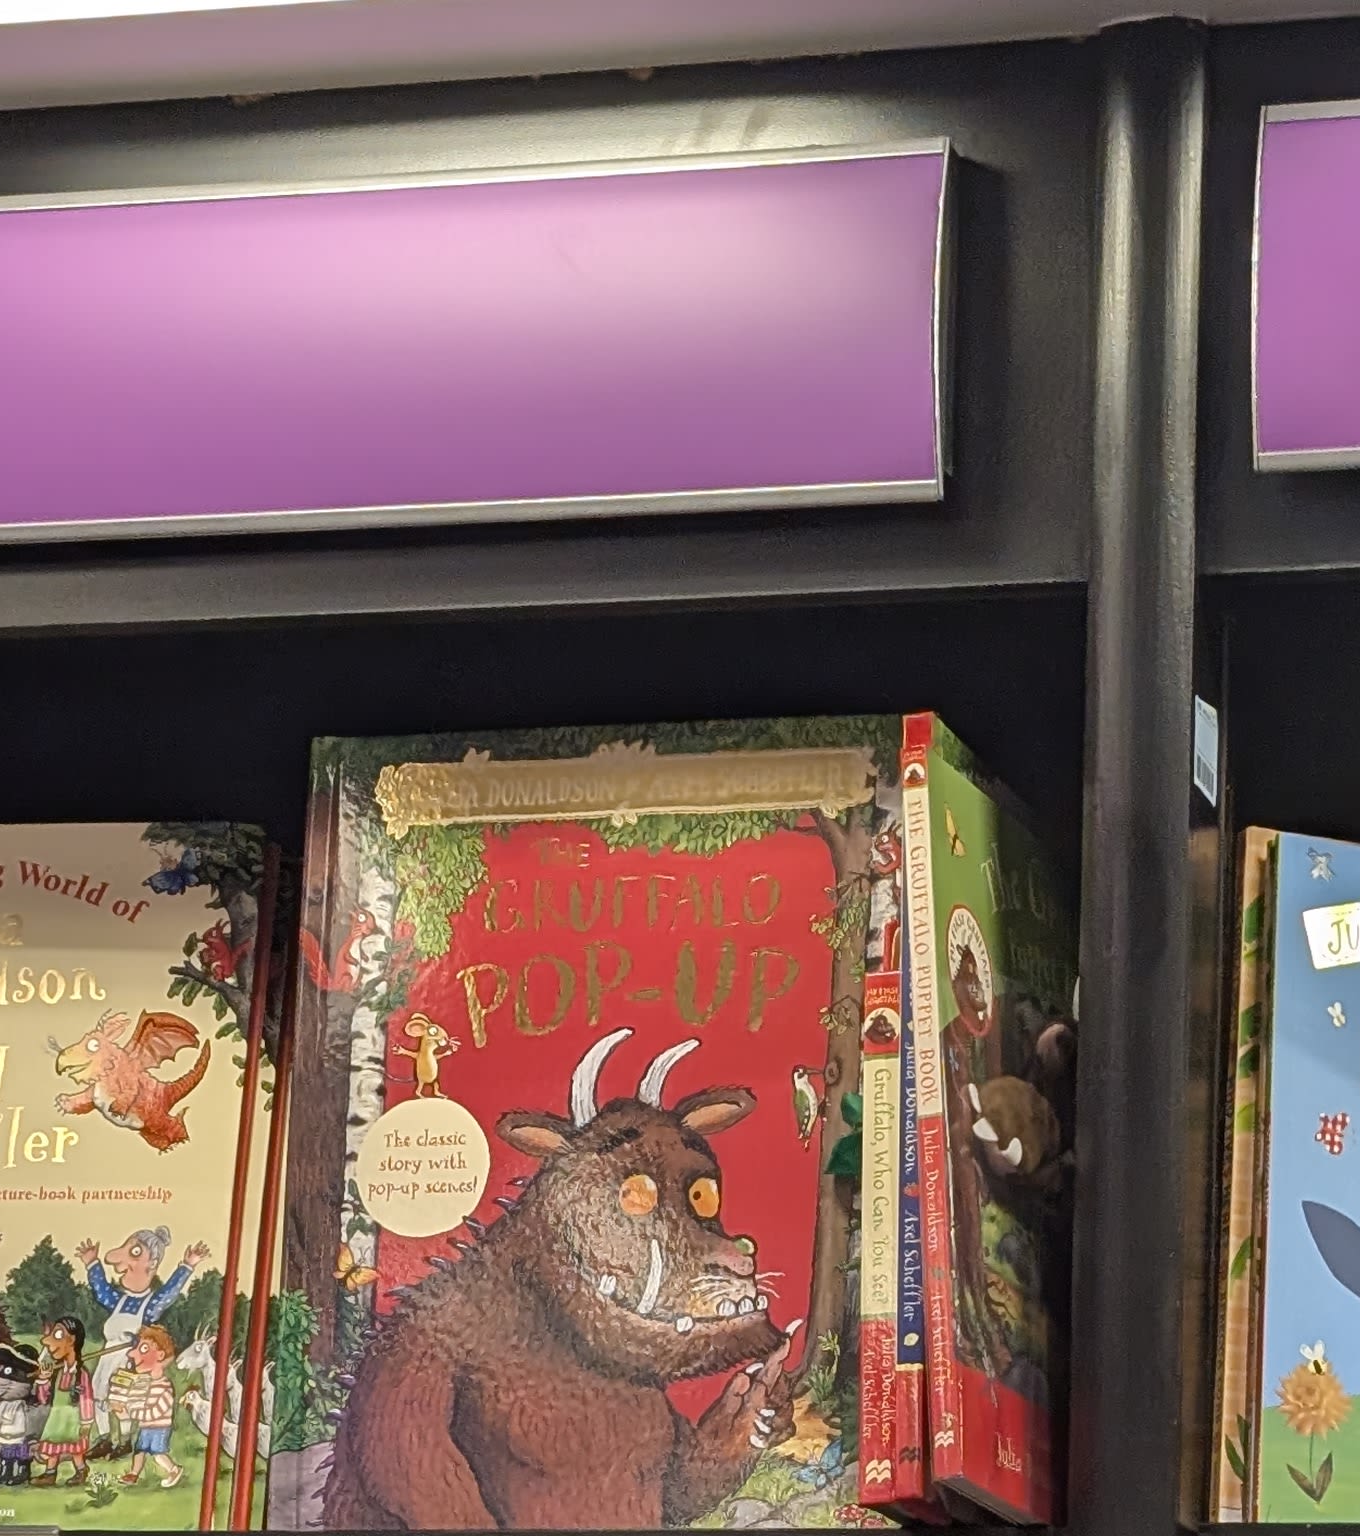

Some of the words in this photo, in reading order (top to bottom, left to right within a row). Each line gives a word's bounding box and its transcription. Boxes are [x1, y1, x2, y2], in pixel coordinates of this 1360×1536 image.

[908, 798, 925, 839] THE
[17, 860, 109, 910] World
[111, 897, 151, 927] of
[483, 873, 782, 934] GRUFFALO
[910, 846, 930, 956] GRUFFALO
[457, 937, 801, 1049] POP-UP
[915, 966, 933, 1037] PUPPET
[919, 1048, 939, 1106] BOOK
[871, 1068, 894, 1146] Gruffalo,
[384, 1129, 411, 1148] The
[416, 1129, 467, 1148] classic
[921, 1126, 940, 1165] Julia
[378, 1155, 423, 1175] story
[428, 1152, 468, 1170] with
[873, 1150, 893, 1190] Who
[80, 1185, 174, 1207] partnership
[368, 1181, 421, 1202] pop-up
[424, 1175, 478, 1194] scenes!
[871, 1193, 891, 1231] Can
[925, 1170, 944, 1253] Donaldson
[871, 1235, 889, 1270] You
[871, 1272, 890, 1307] See?
[903, 1248, 922, 1323] Scheffler
